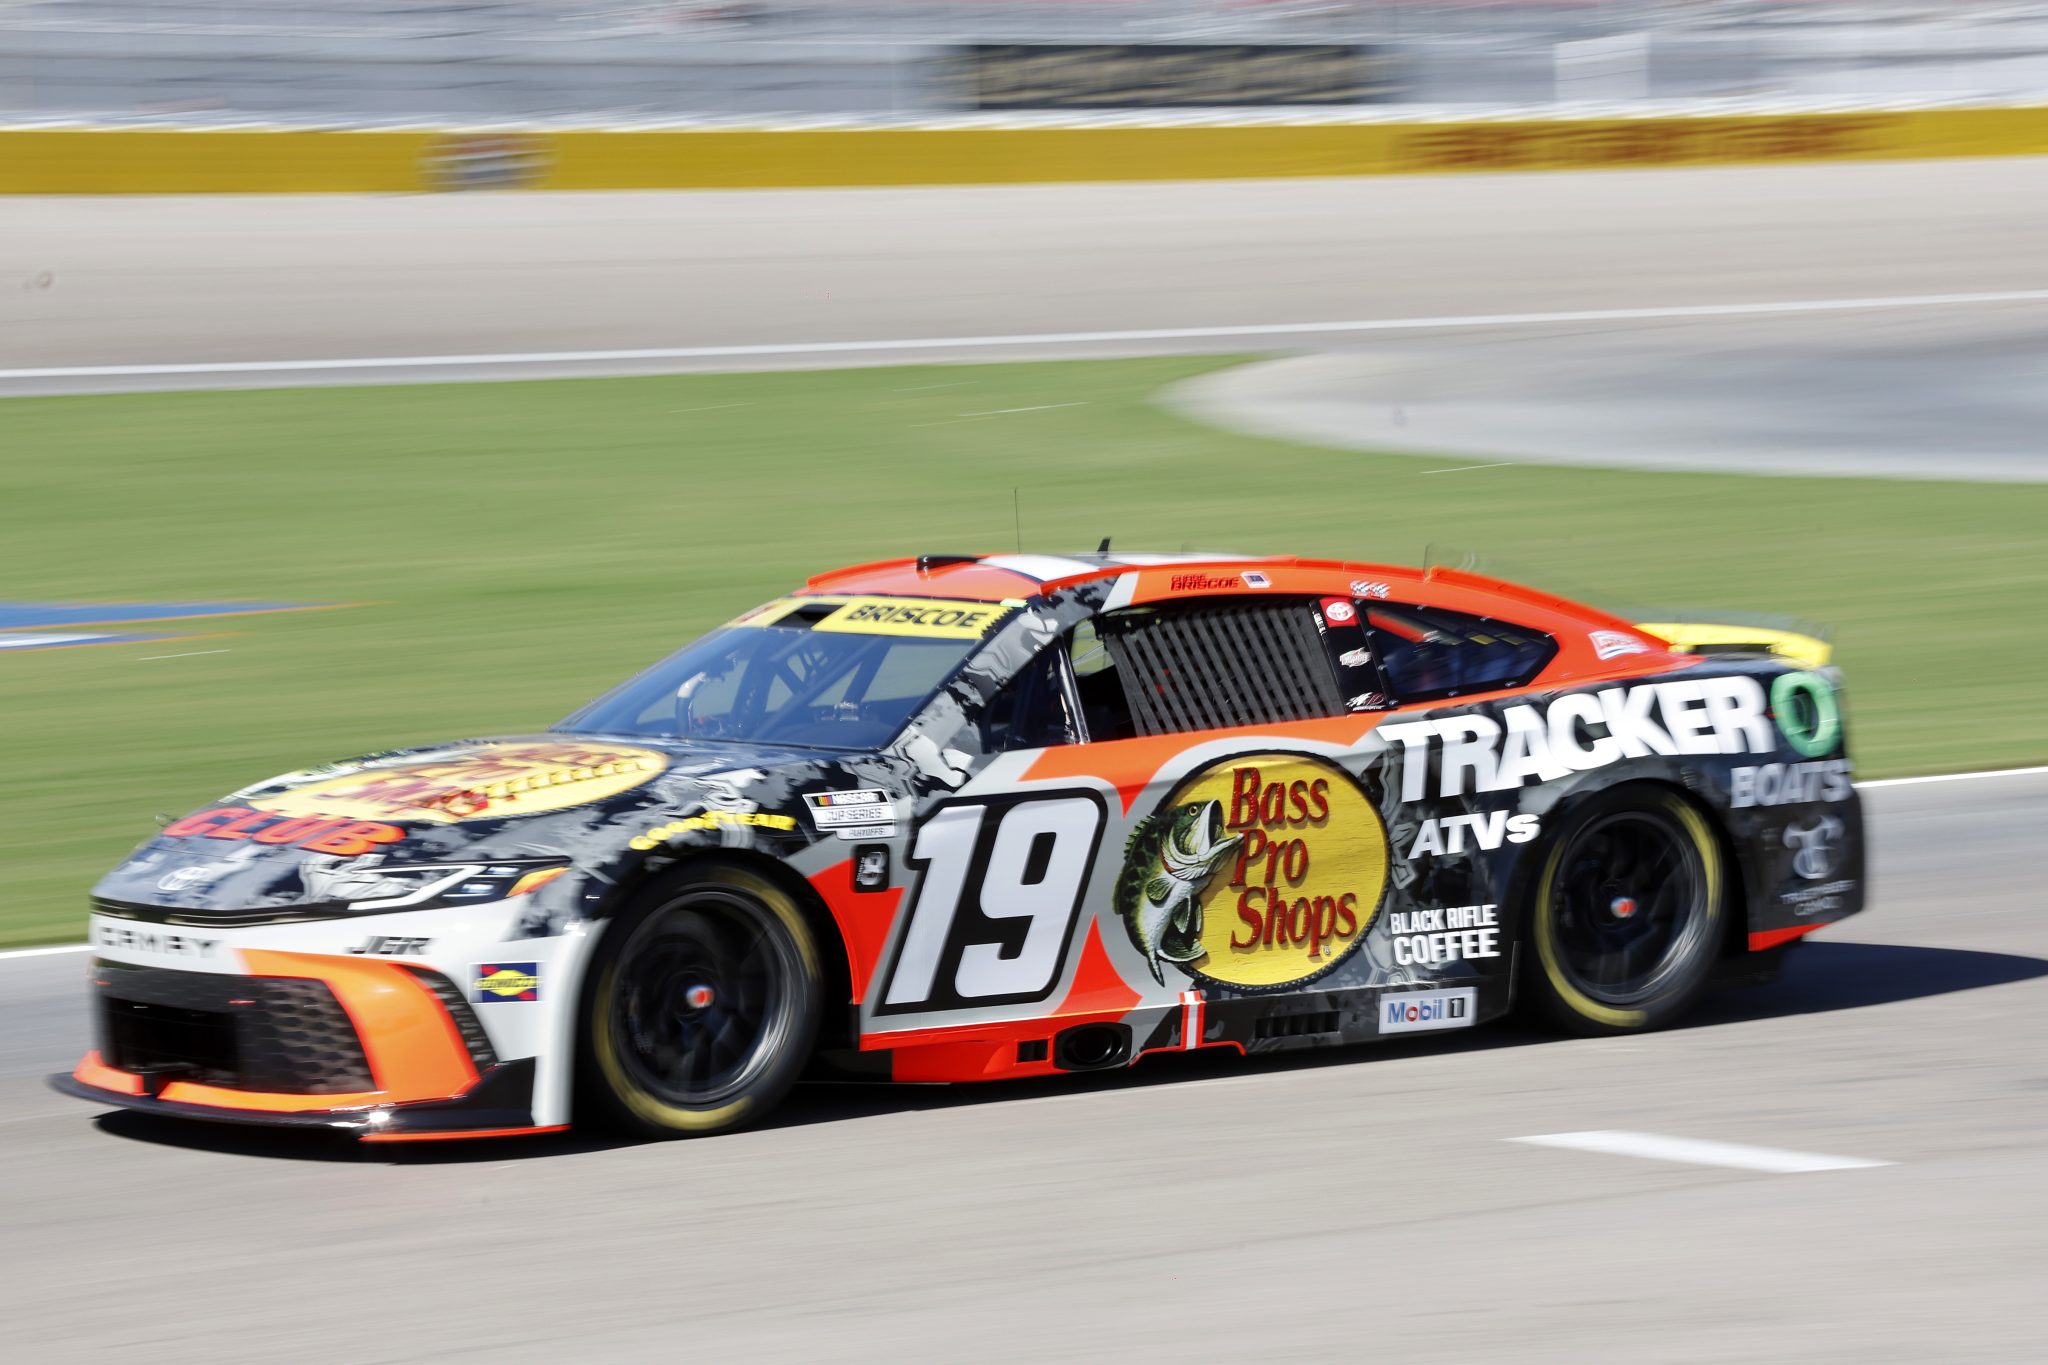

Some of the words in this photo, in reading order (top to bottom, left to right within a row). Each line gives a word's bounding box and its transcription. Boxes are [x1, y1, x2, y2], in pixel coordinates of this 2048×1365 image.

[1170, 577, 1241, 592] BRISCOE
[847, 603, 989, 628] BRISCOE
[1376, 675, 1776, 803] TRACKER
[1226, 767, 1329, 828] Bass
[1730, 759, 1854, 808] BOATS
[162, 807, 407, 857] CLUB
[826, 810, 844, 821] CUP
[846, 807, 883, 820] SERIES
[1408, 810, 1541, 860] ATVs
[1229, 828, 1309, 886] Pro
[884, 797, 1100, 1005] 19
[1230, 886, 1357, 957] Shops
[1390, 908, 1447, 935] BLACK
[1446, 904, 1499, 929] RIFLE
[350, 935, 434, 956] JGR
[1393, 928, 1500, 966] COFFEE
[1387, 1000, 1443, 1024] Mobil
[1448, 998, 1465, 1018] 1
